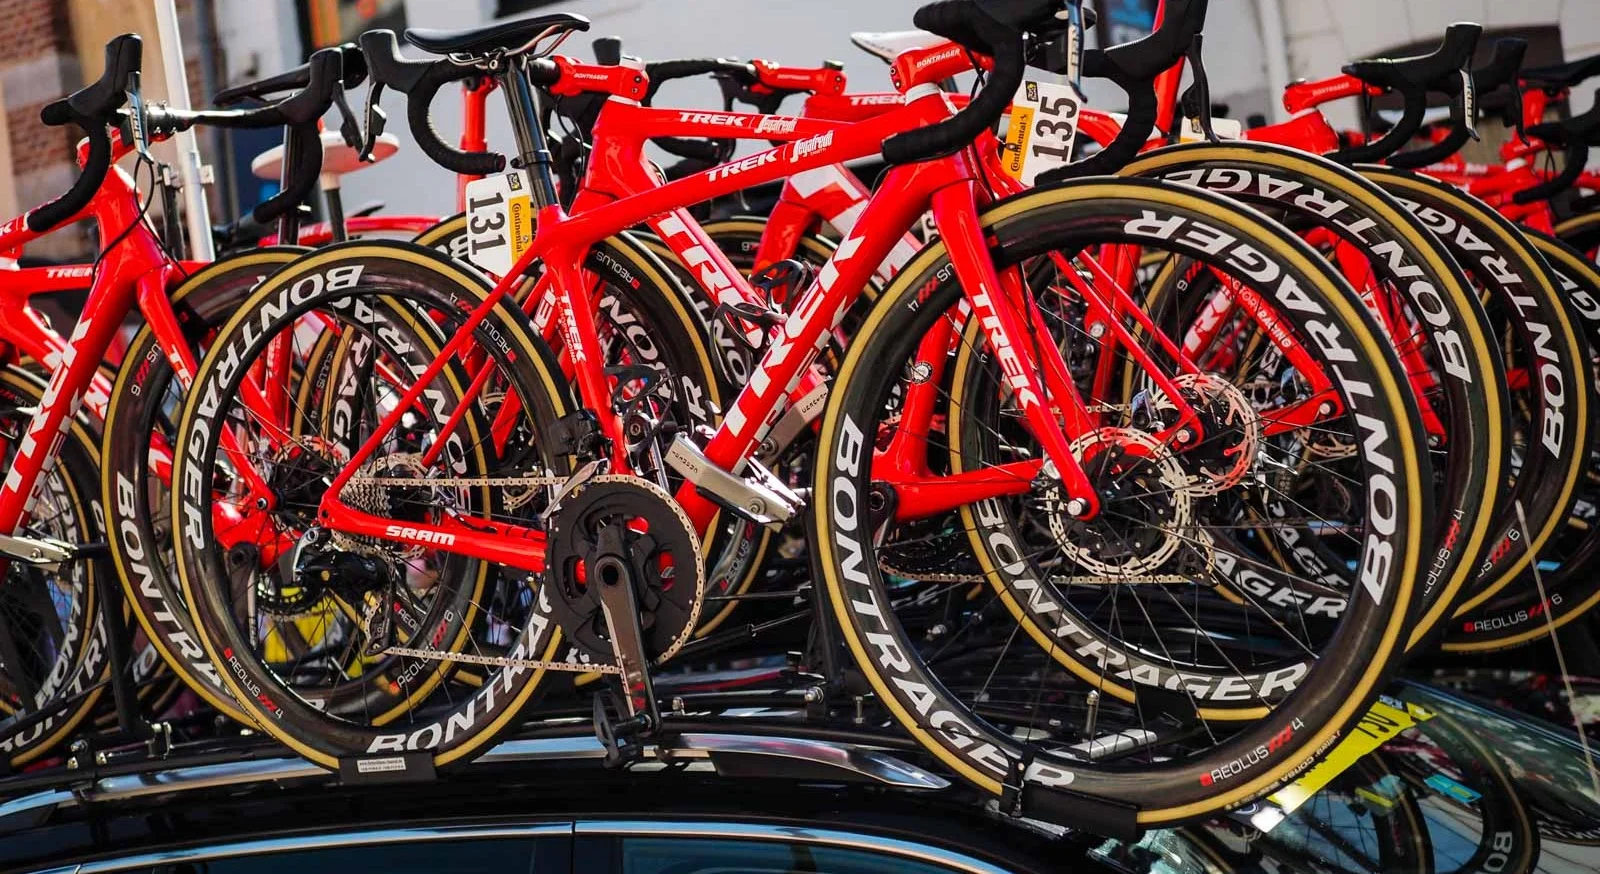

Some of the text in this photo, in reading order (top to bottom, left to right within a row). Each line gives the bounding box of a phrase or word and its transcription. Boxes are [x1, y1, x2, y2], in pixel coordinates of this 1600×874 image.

[916, 48, 961, 68] BONTRAGER
[679, 111, 747, 127] TREK
[851, 96, 907, 106] TREK
[1032, 96, 1078, 162] 135
[705, 149, 778, 182] TREK
[1010, 121, 1027, 172] Continental
[469, 192, 506, 256] 131
[511, 203, 523, 253] Continental
[596, 250, 635, 283] AEOLUS
[1161, 167, 1472, 384] BONTRAGE
[480, 318, 512, 355] AEOLU
[561, 290, 587, 362] TREK
[725, 235, 866, 438] TREK
[973, 283, 1041, 410] TREK
[1257, 307, 1293, 348] RACING
[4, 318, 93, 493] TREK
[183, 265, 365, 550] BONTRAGER
[1123, 210, 1397, 606] BONTRAGER
[386, 525, 456, 546] SRAM
[444, 609, 454, 622] 6
[832, 413, 1075, 787] BONTRAGER
[974, 497, 1307, 701] BONTRAGER
[1474, 610, 1528, 631] AEOLUS
[1551, 593, 1563, 606] 6
[228, 656, 261, 697] AEOLUS
[275, 708, 284, 719] 4
[1211, 745, 1270, 783] AEOLUS
[1292, 717, 1305, 731] 4
